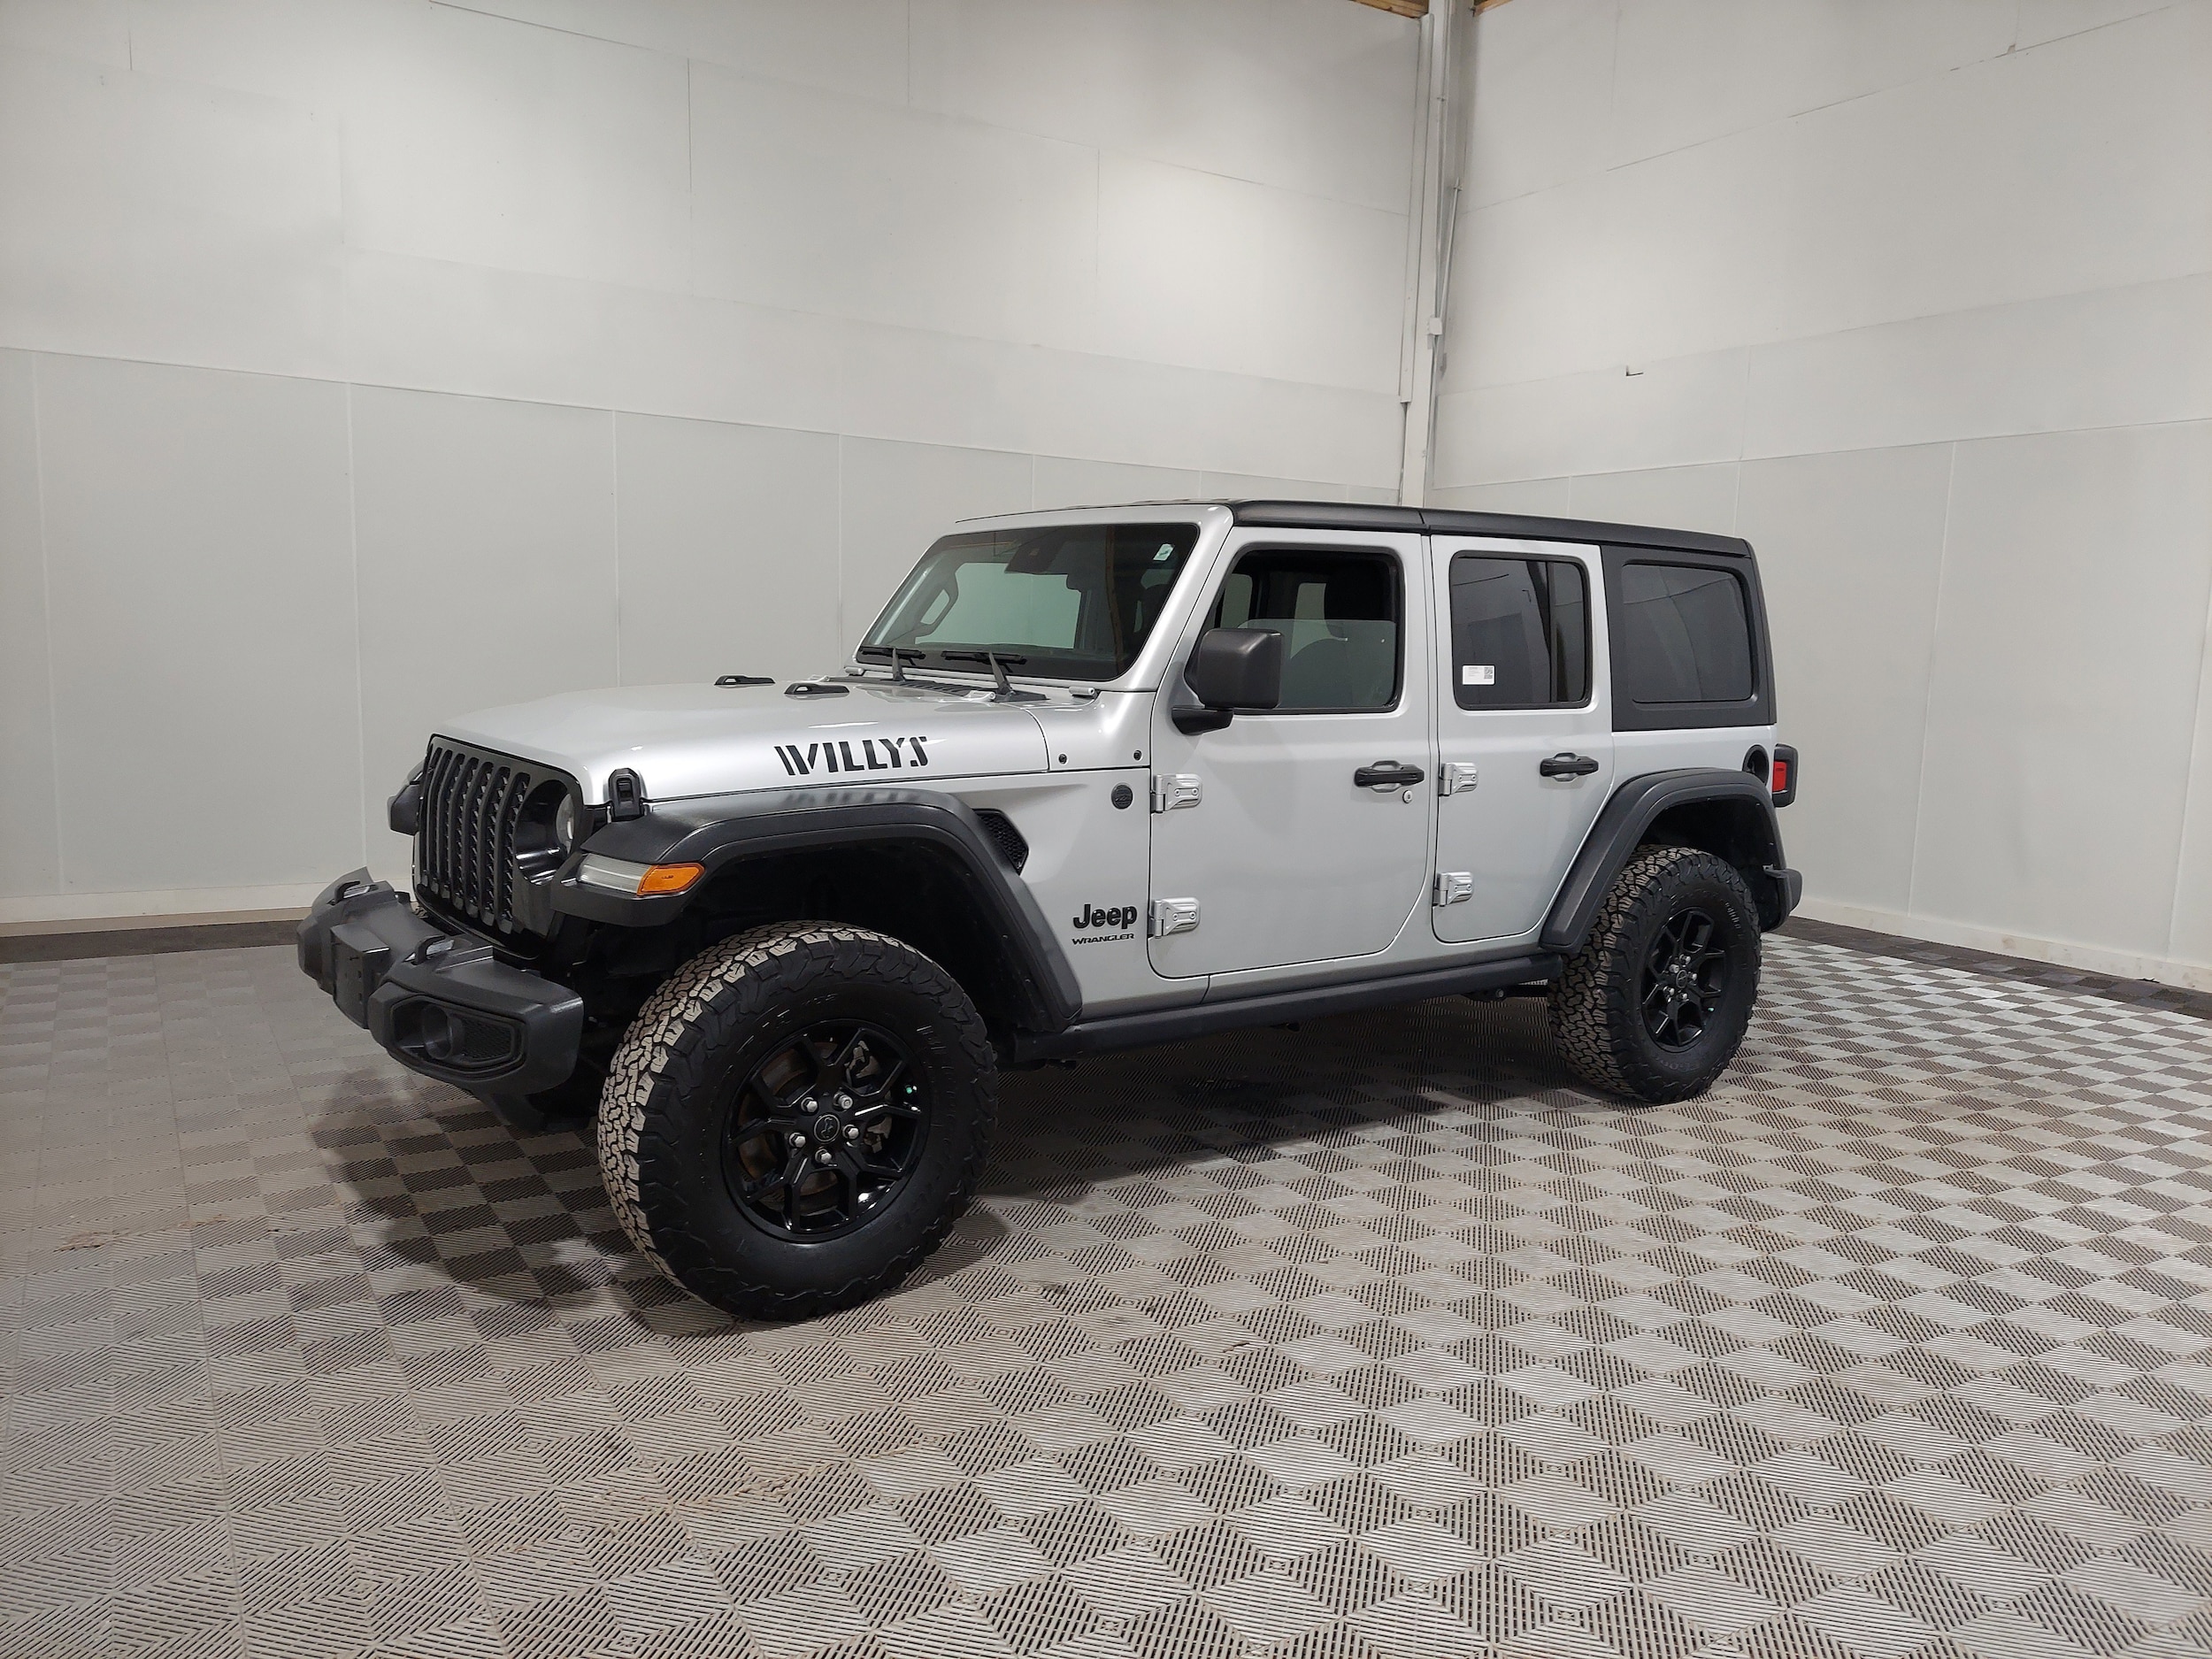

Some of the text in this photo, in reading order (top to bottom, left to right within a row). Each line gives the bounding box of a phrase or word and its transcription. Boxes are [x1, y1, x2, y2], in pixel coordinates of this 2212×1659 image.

[773, 736, 928, 776] WILLYS
[1072, 903, 1138, 930] Jeep
[1071, 933, 1134, 945] WRANGLER
